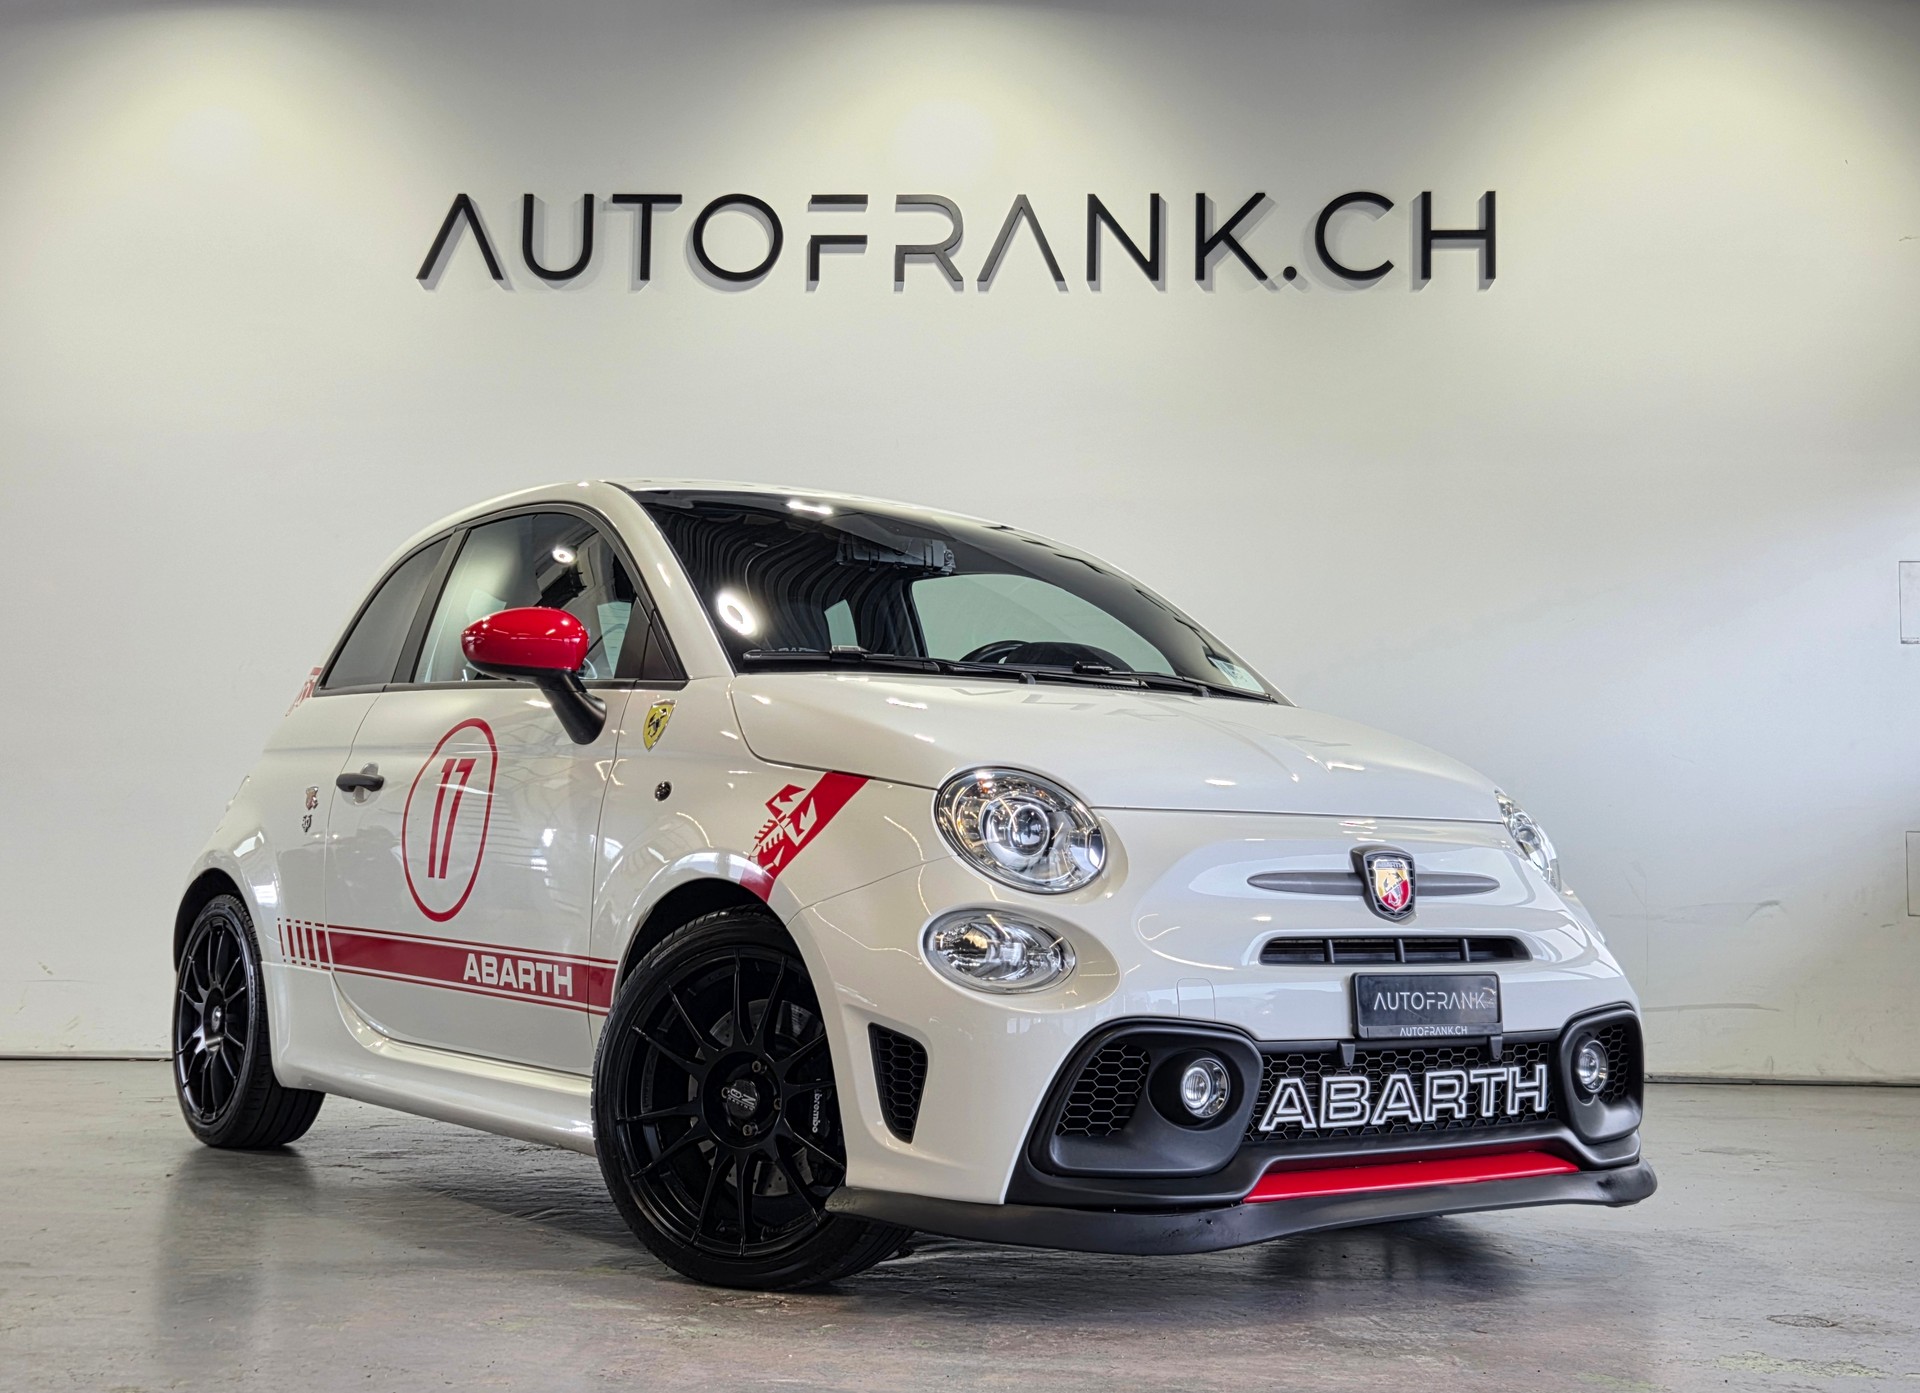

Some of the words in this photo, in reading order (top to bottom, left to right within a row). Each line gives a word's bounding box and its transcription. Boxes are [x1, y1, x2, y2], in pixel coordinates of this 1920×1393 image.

[416, 190, 1497, 288] AUTOFRANK.CH
[463, 953, 573, 997] ABARTH
[1373, 991, 1486, 1011] AUTOFRANK
[1400, 1026, 1468, 1037] AUTOFRANK.CH
[812, 1092, 823, 1133] brembo
[1258, 1064, 1547, 1131] ABARTH
